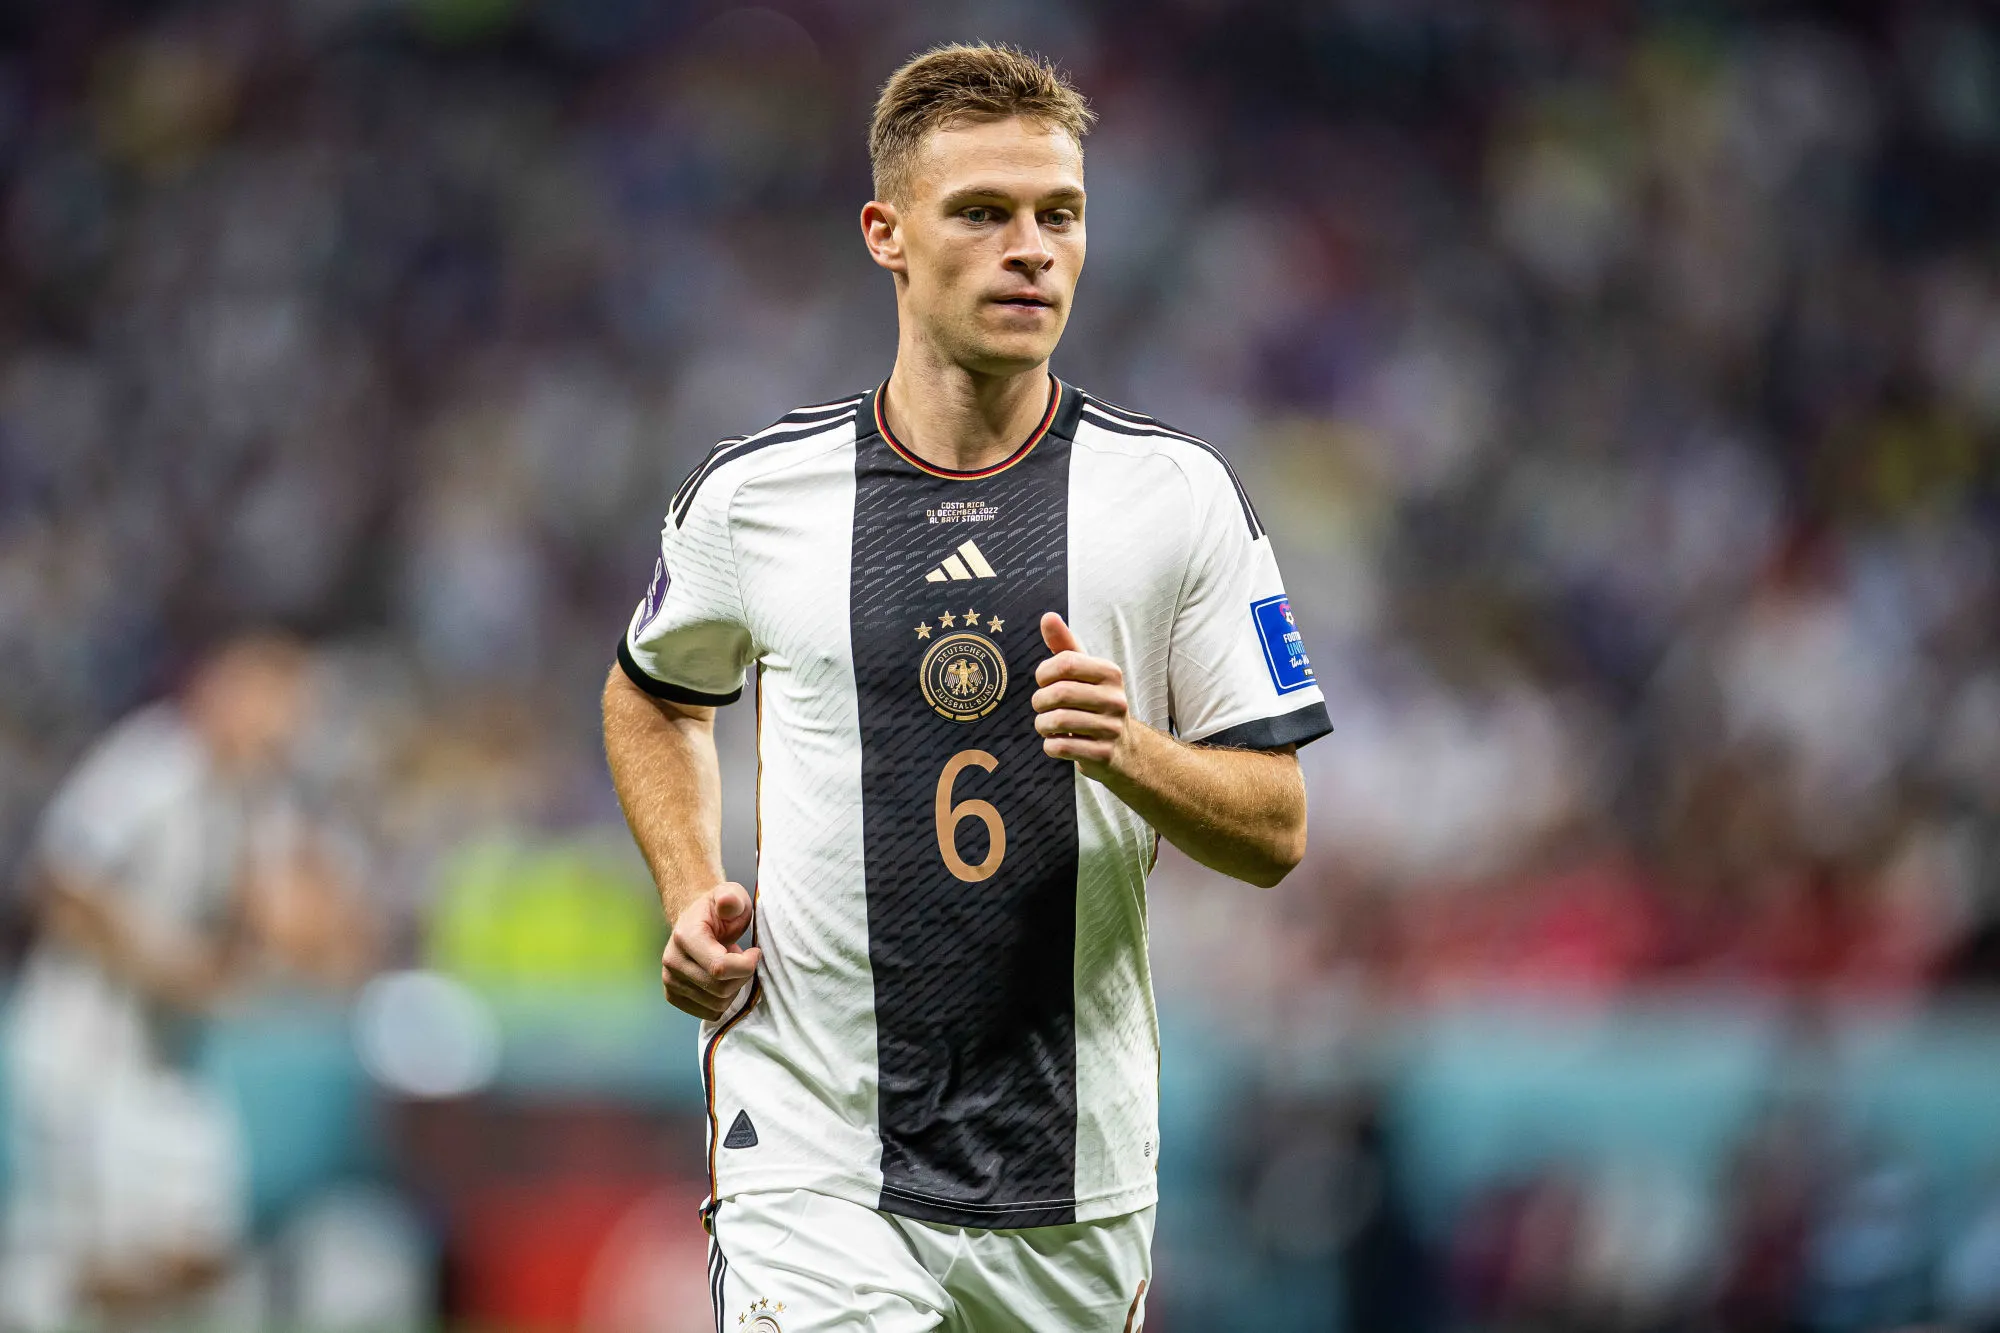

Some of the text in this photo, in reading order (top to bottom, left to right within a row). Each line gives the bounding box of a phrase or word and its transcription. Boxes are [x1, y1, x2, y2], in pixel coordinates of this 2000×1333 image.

[926, 509, 935, 517] 01
[937, 508, 977, 517] DECEMBER
[961, 514, 995, 522] STADIUM
[937, 645, 987, 663] DEUTSCHER
[935, 683, 995, 710] FUSSBALL-BUND
[935, 749, 1006, 882] 6
